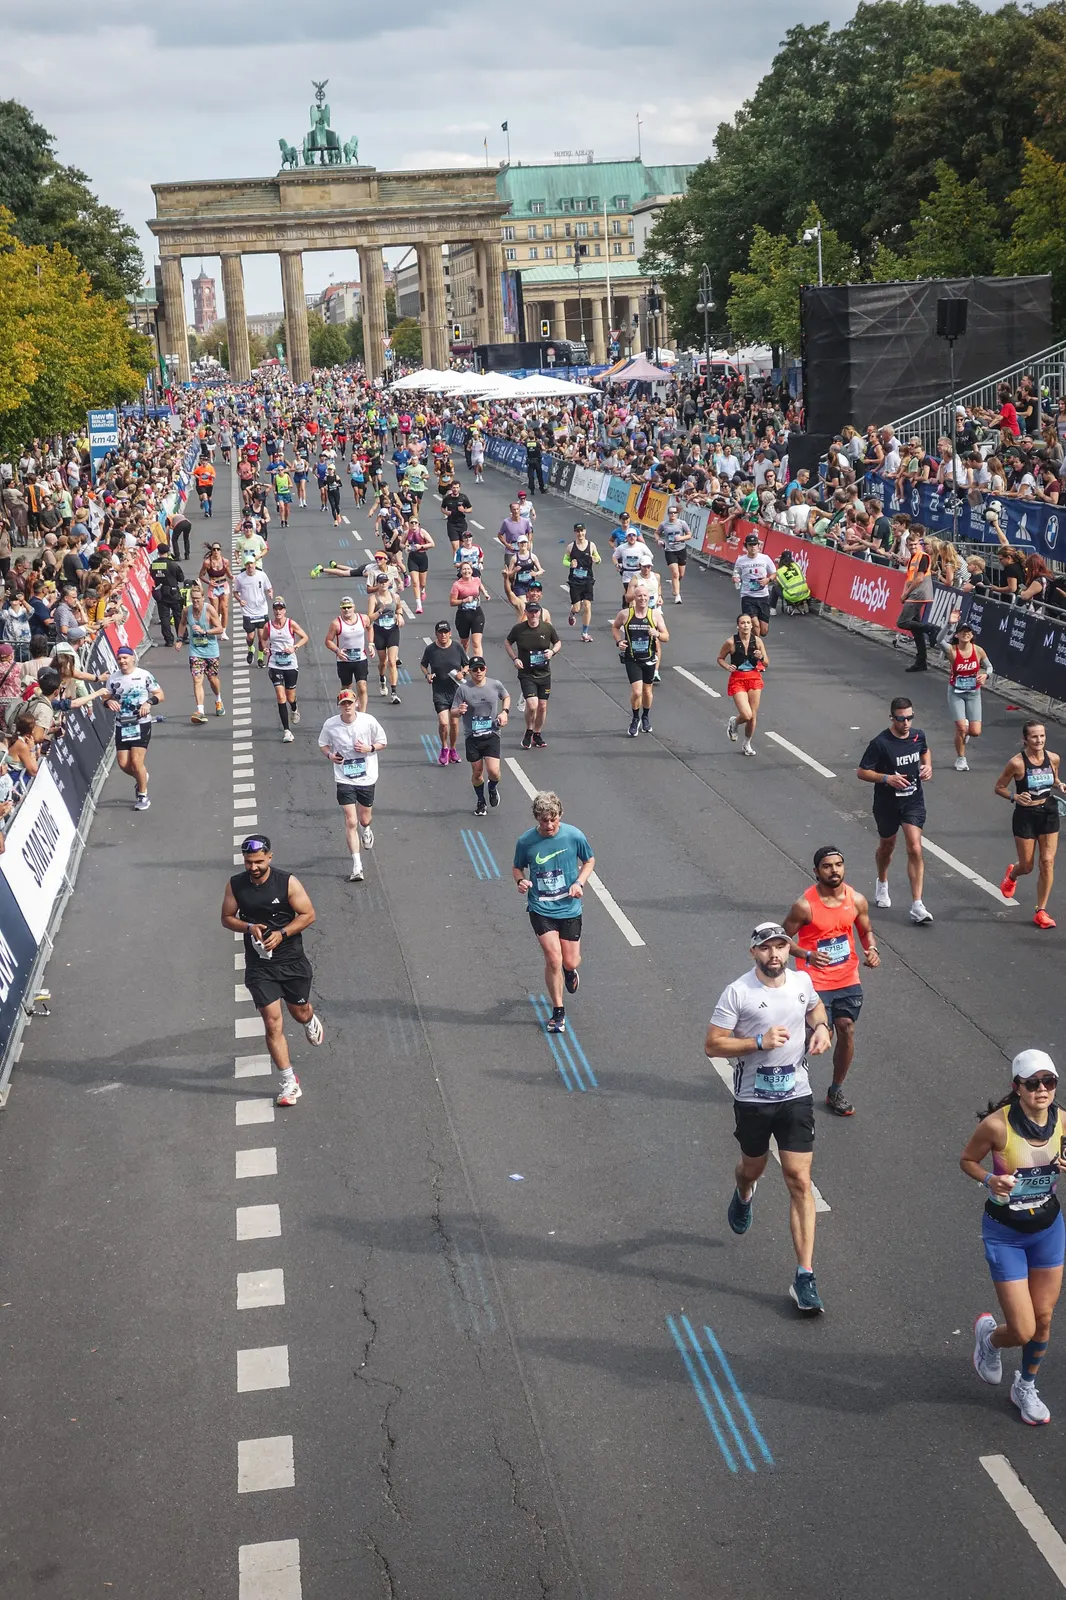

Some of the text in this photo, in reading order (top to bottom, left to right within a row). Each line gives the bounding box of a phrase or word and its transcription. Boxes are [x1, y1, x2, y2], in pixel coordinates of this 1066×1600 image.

[92, 436, 105, 444] km
[849, 575, 890, 612] HubSpot
[1014, 618, 1026, 628] Maurten
[1012, 628, 1026, 640] Hydrogel
[1009, 638, 1026, 652] Technology
[22, 800, 60, 888] SAMSUNG
[763, 1074, 790, 1084] 83370
[1020, 1177, 1051, 1187] 77663
